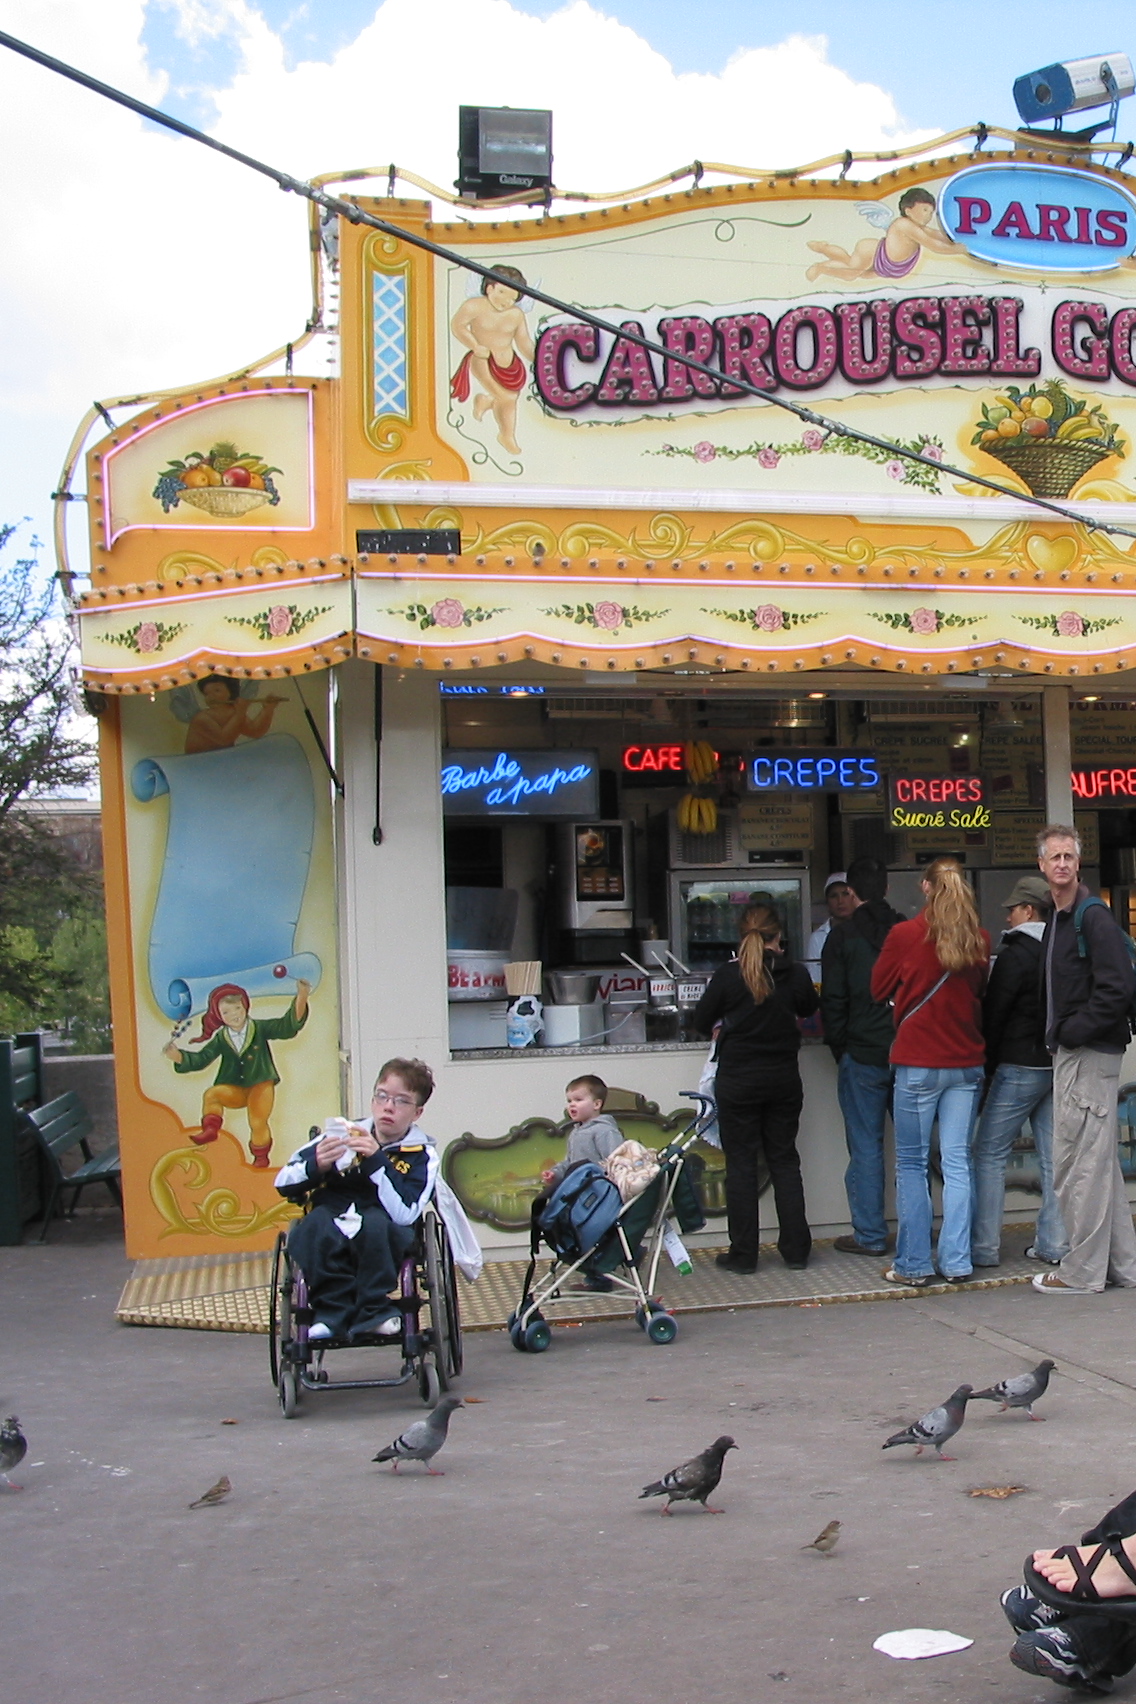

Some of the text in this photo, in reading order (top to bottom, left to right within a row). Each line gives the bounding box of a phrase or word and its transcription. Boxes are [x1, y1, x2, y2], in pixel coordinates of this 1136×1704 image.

[499, 174, 534, 187] Galaxy
[954, 195, 1128, 248] PARIS
[535, 295, 1041, 411] CARROUSEL
[622, 746, 683, 771] CAFE
[752, 757, 880, 788] CREPES
[440, 752, 521, 795] Barbe
[896, 779, 983, 802] CREPES
[891, 804, 992, 829] Sucré Salé
